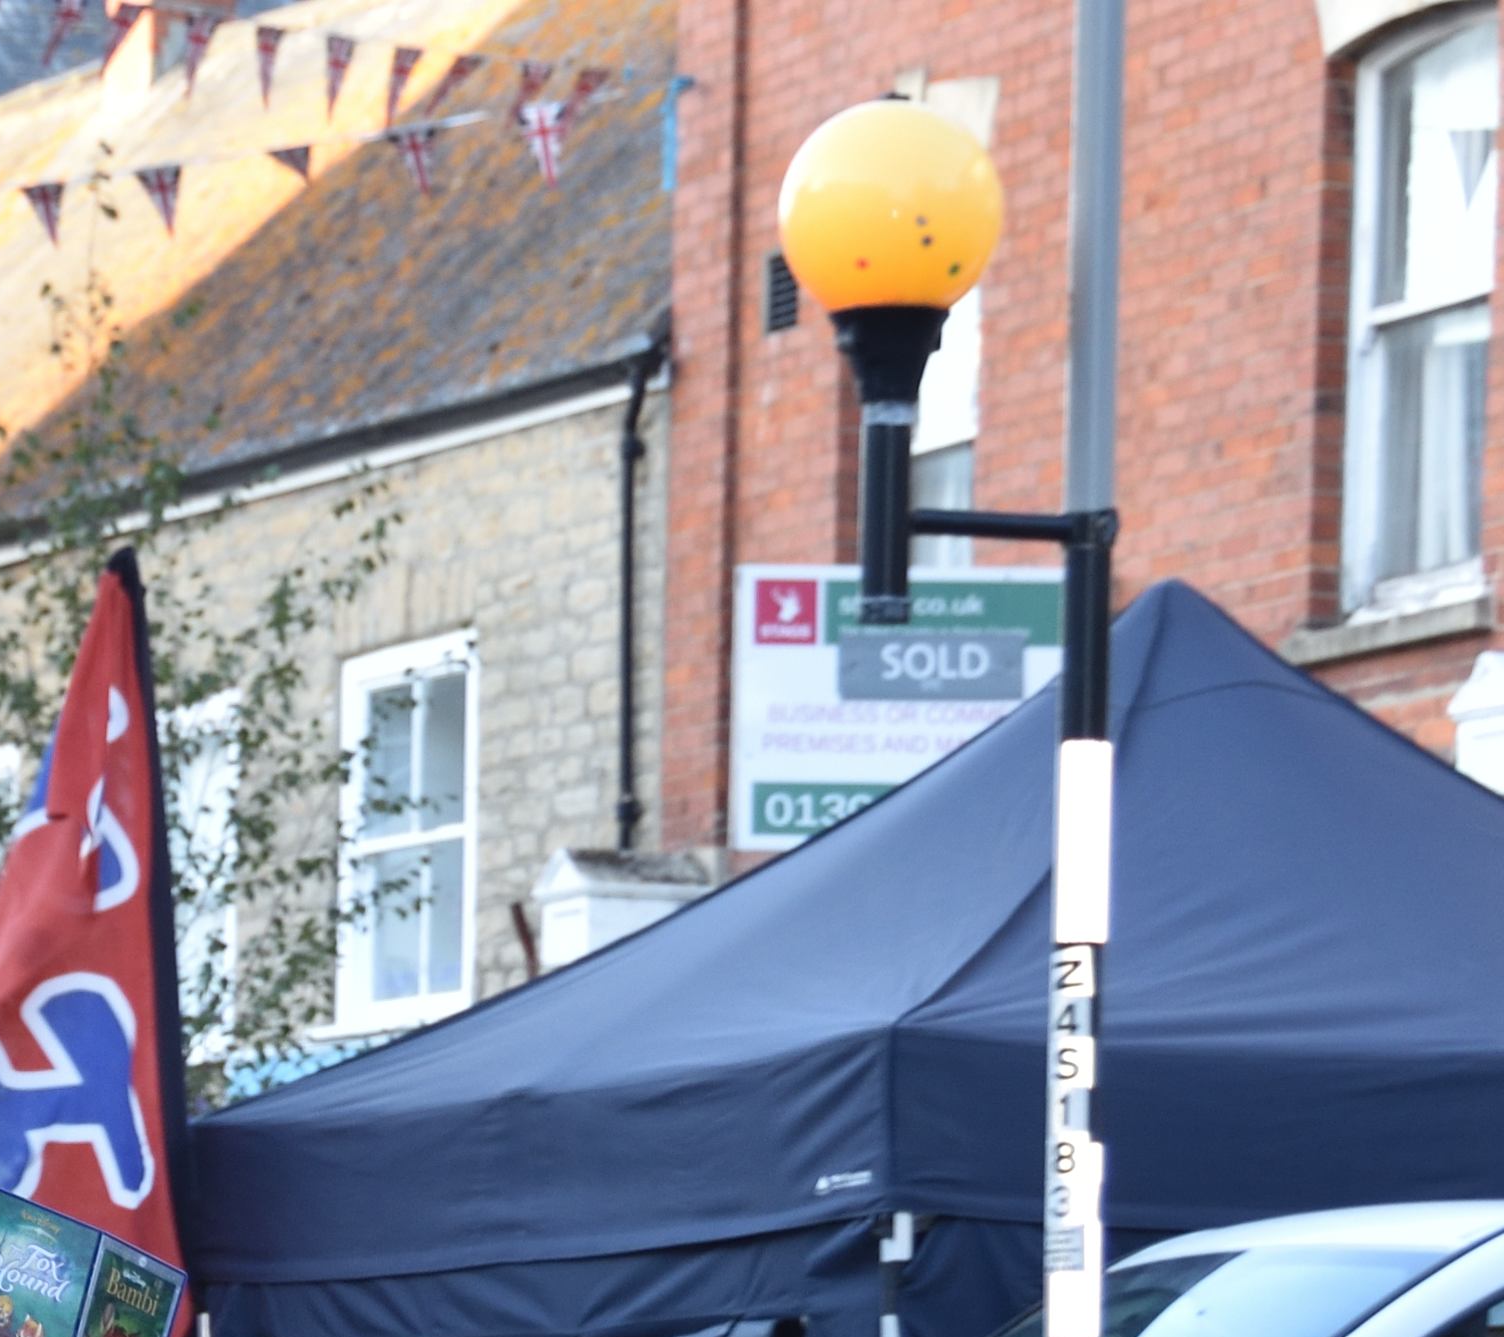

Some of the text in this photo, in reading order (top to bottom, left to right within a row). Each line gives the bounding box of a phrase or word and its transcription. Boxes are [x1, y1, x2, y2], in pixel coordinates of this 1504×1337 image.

[880, 641, 990, 680] SOLD
[24, 1244, 66, 1281] Fox
[105, 1266, 162, 1318] Bambi
